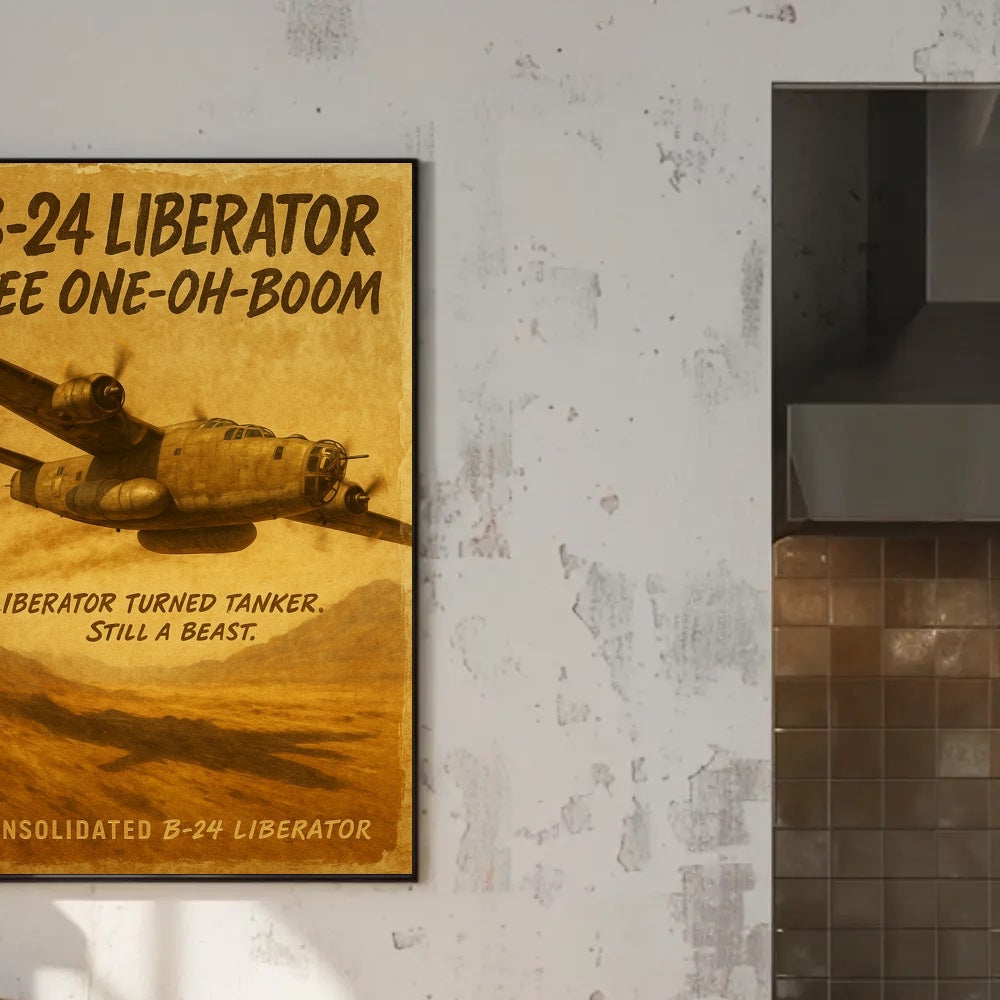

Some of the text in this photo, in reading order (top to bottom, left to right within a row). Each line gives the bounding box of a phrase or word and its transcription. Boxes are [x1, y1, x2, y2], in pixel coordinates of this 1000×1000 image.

[104, 192, 380, 257] LIBERATOR
[58, 267, 383, 318] ONE-OH-BOOM
[125, 592, 217, 614] TURNED
[225, 592, 326, 614] TANKER.
[85, 620, 257, 643] STILL A BEAST.
[162, 818, 224, 841] B-24
[233, 818, 372, 841] LIBERATOR
